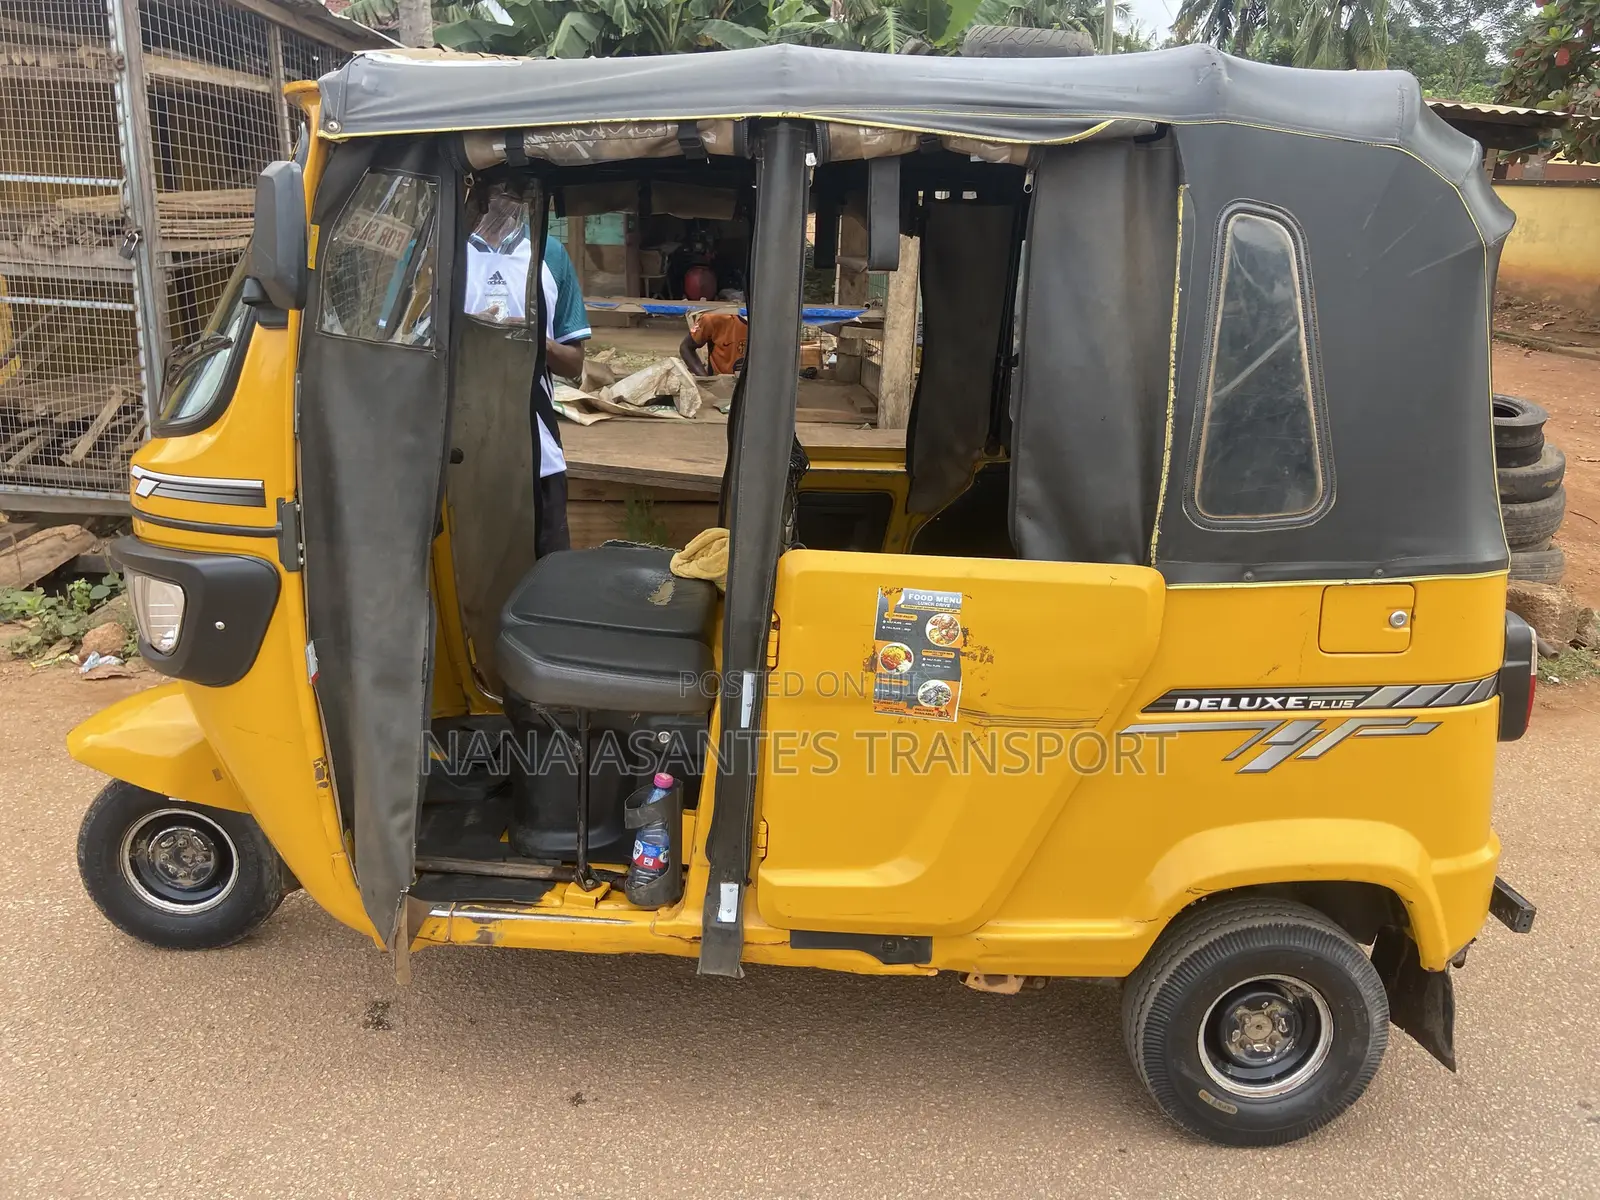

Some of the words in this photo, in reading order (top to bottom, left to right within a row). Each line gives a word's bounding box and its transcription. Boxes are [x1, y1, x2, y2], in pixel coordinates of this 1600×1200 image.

[908, 593, 934, 602] FOOD
[935, 596, 962, 605] MENU
[1174, 696, 1309, 711] DELUXE
[1308, 699, 1355, 709] PLUS
